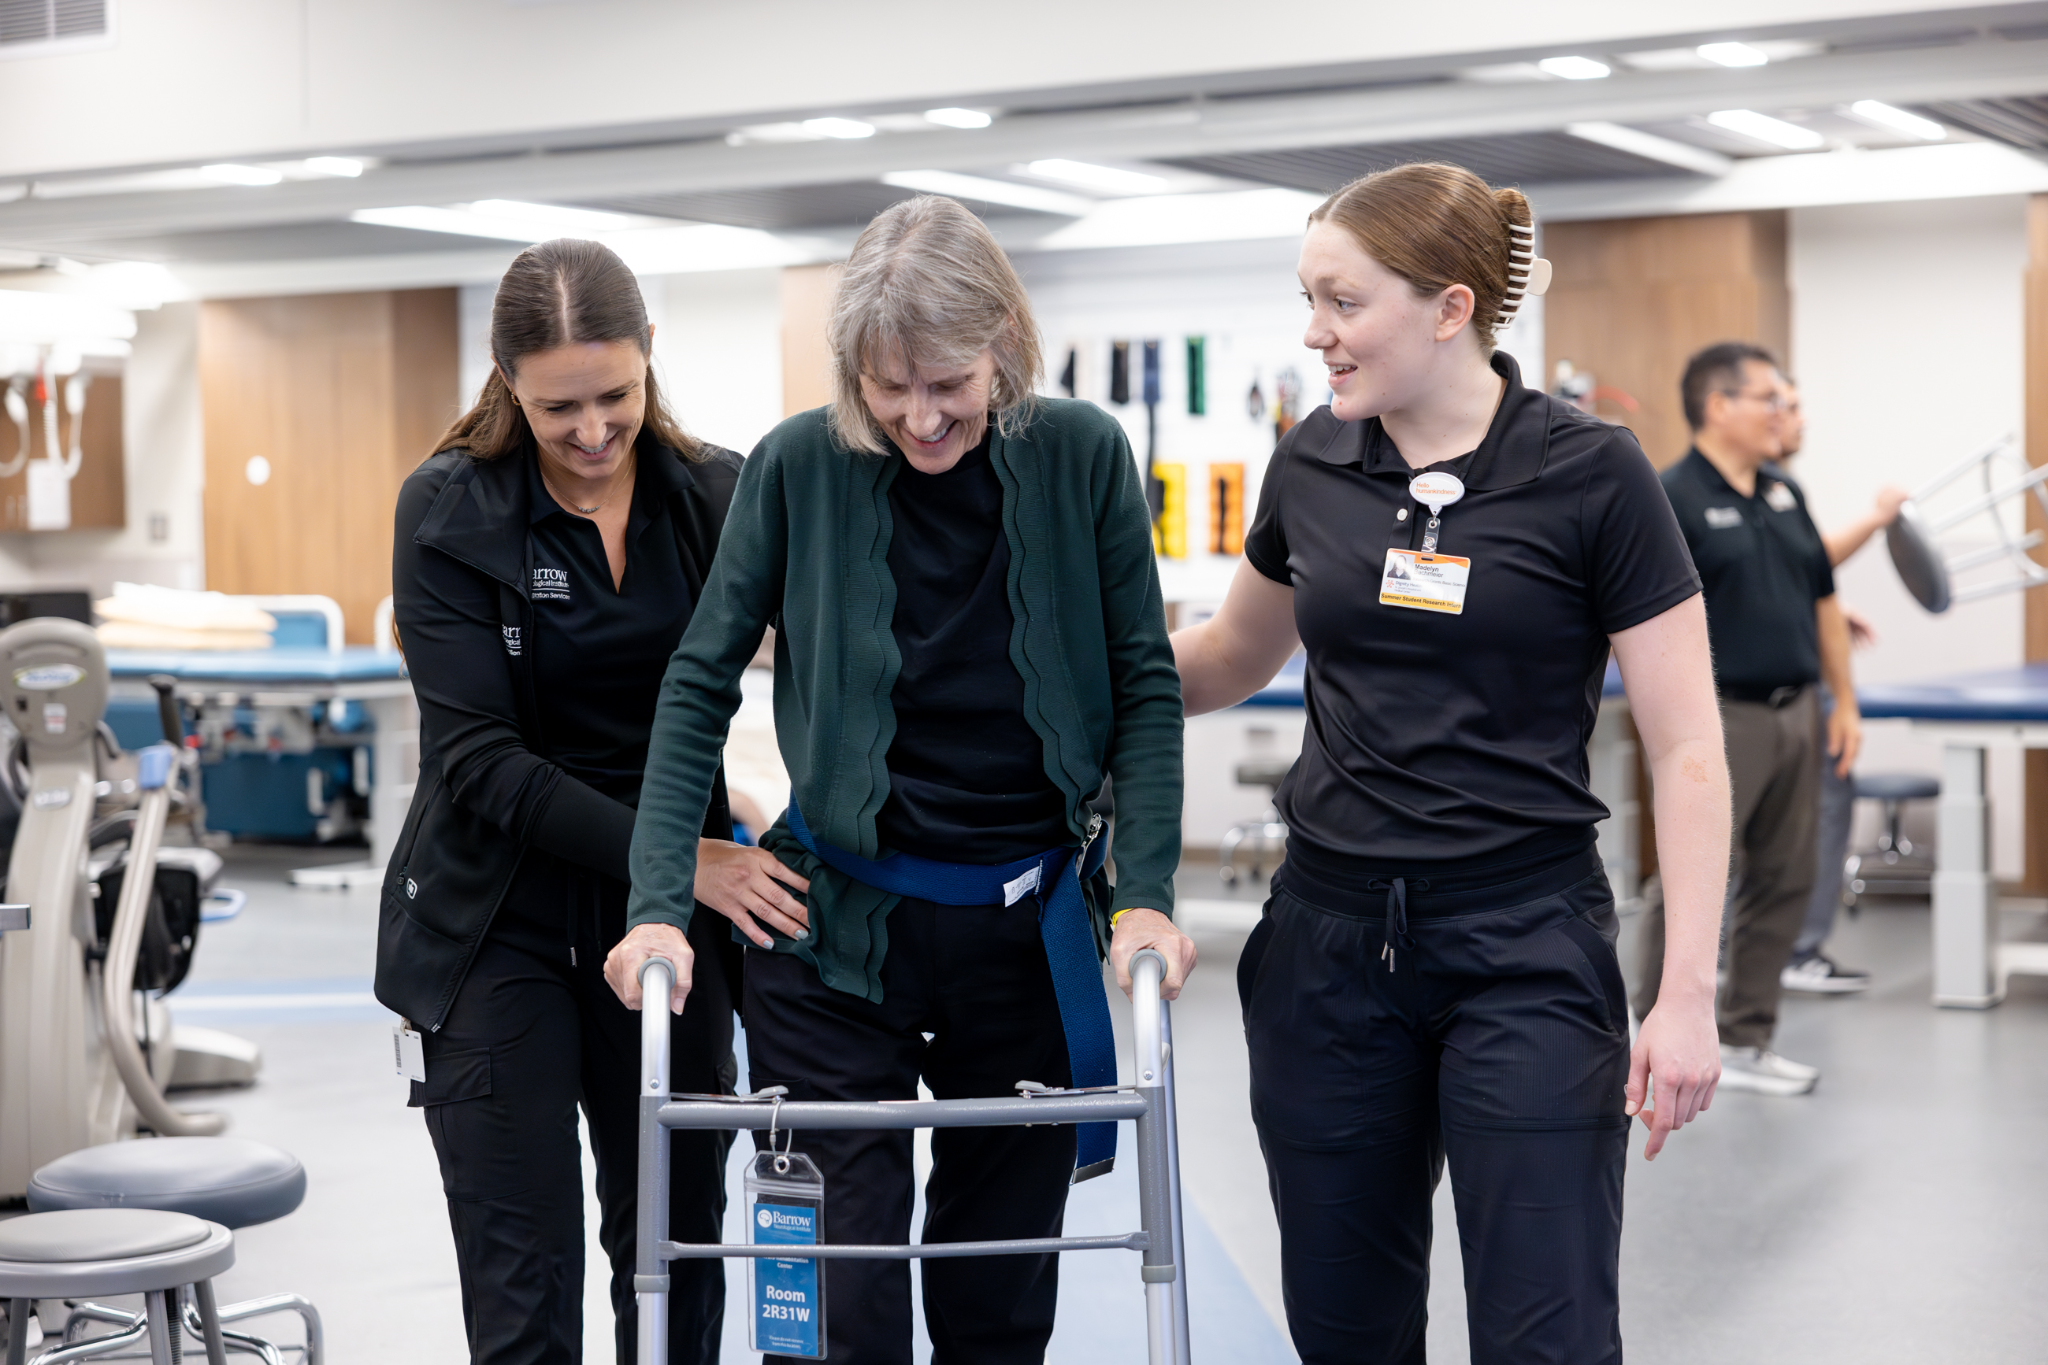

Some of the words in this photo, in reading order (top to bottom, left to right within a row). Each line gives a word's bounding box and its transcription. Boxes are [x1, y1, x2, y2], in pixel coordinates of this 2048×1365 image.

[533, 568, 568, 582] arrow
[1381, 593, 1402, 601] Summer
[772, 1211, 812, 1227] Barrow
[766, 1285, 806, 1303] Room
[762, 1304, 811, 1322] 2R31W
